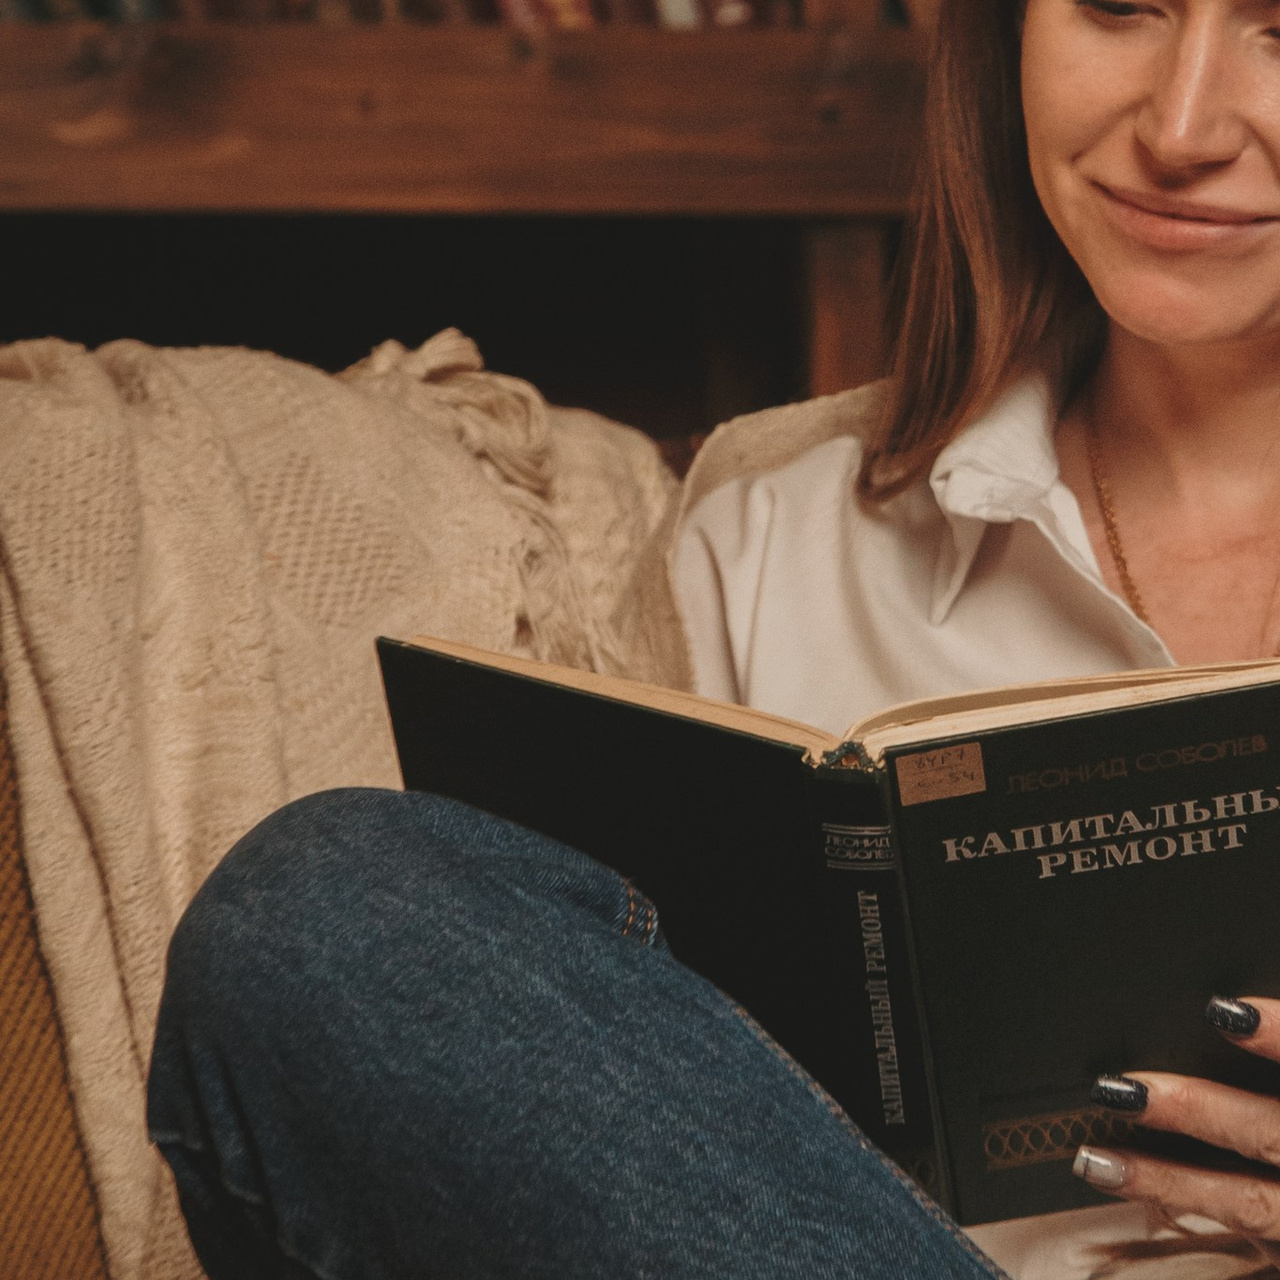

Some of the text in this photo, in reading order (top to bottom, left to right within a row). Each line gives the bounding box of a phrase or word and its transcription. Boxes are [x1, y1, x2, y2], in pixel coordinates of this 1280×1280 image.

[1006, 734, 1269, 796] ЛЕОНИД СОБОЛЕВ
[825, 834, 891, 848] ЛЕОНИД
[1037, 822, 1248, 879] РЕМОНТ
[857, 890, 906, 1126] КАПИТАЛЬНЫЙ РЕМОНТ
